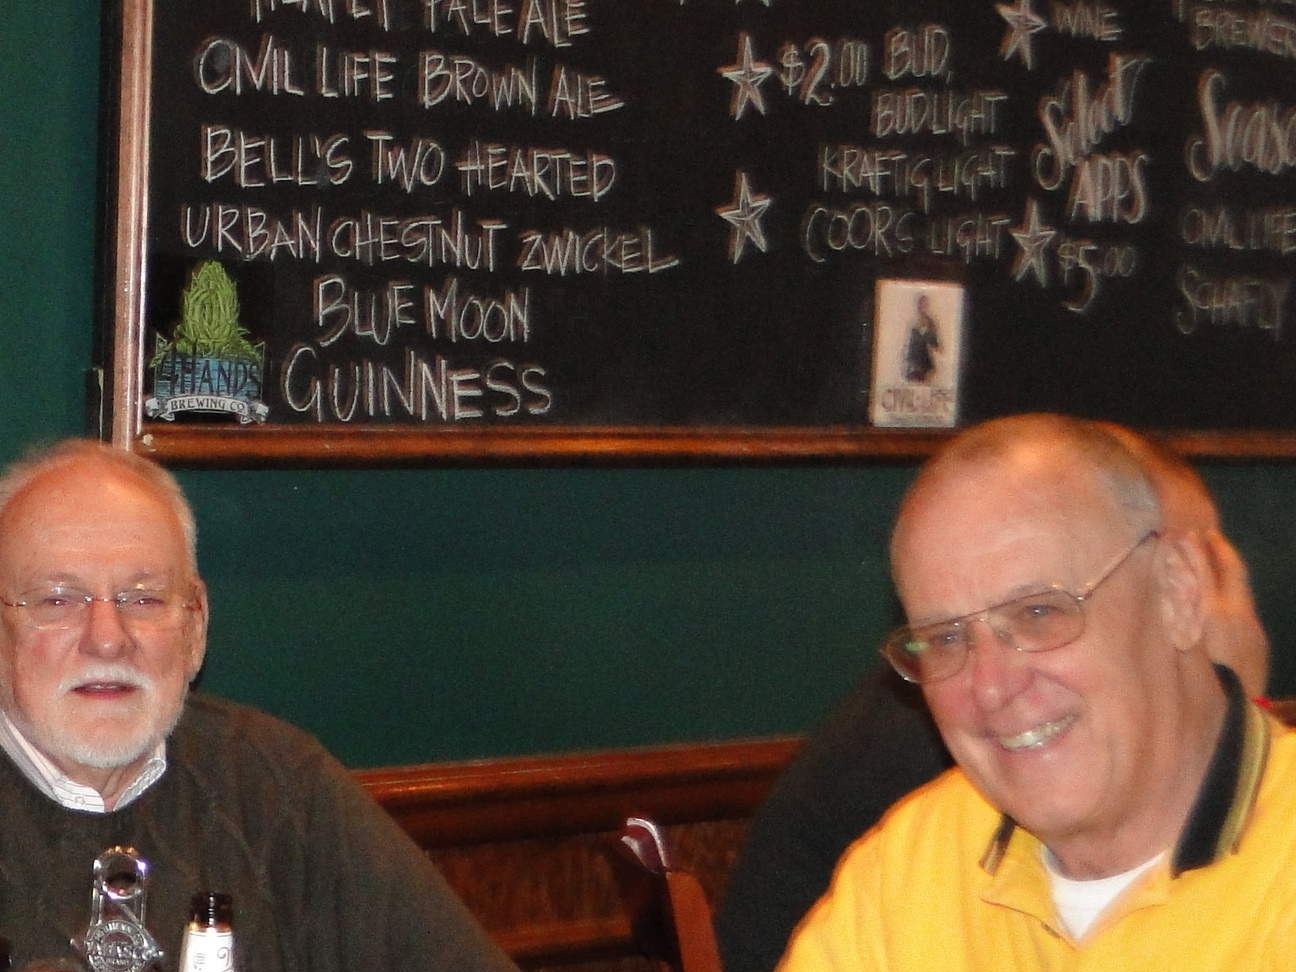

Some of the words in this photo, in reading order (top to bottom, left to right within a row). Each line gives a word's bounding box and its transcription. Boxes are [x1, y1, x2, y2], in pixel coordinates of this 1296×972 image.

[522, 0, 590, 48] ALE
[199, 34, 304, 95] CIVIL
[319, 45, 397, 102] LIFE
[424, 54, 537, 117] BROWN
[553, 66, 625, 120] ALE
[204, 126, 353, 188] BELL'S
[366, 134, 445, 194] TWO
[458, 141, 616, 202] HEARTED
[181, 205, 321, 264] URBAN
[332, 210, 508, 273] CHESTNUT
[521, 228, 680, 275] ZWICKEL
[806, 205, 916, 263] COORS
[314, 276, 416, 348] BLUE
[427, 280, 531, 343] MOON
[170, 398, 225, 411] BREWING
[284, 346, 552, 422] GUINNESS
